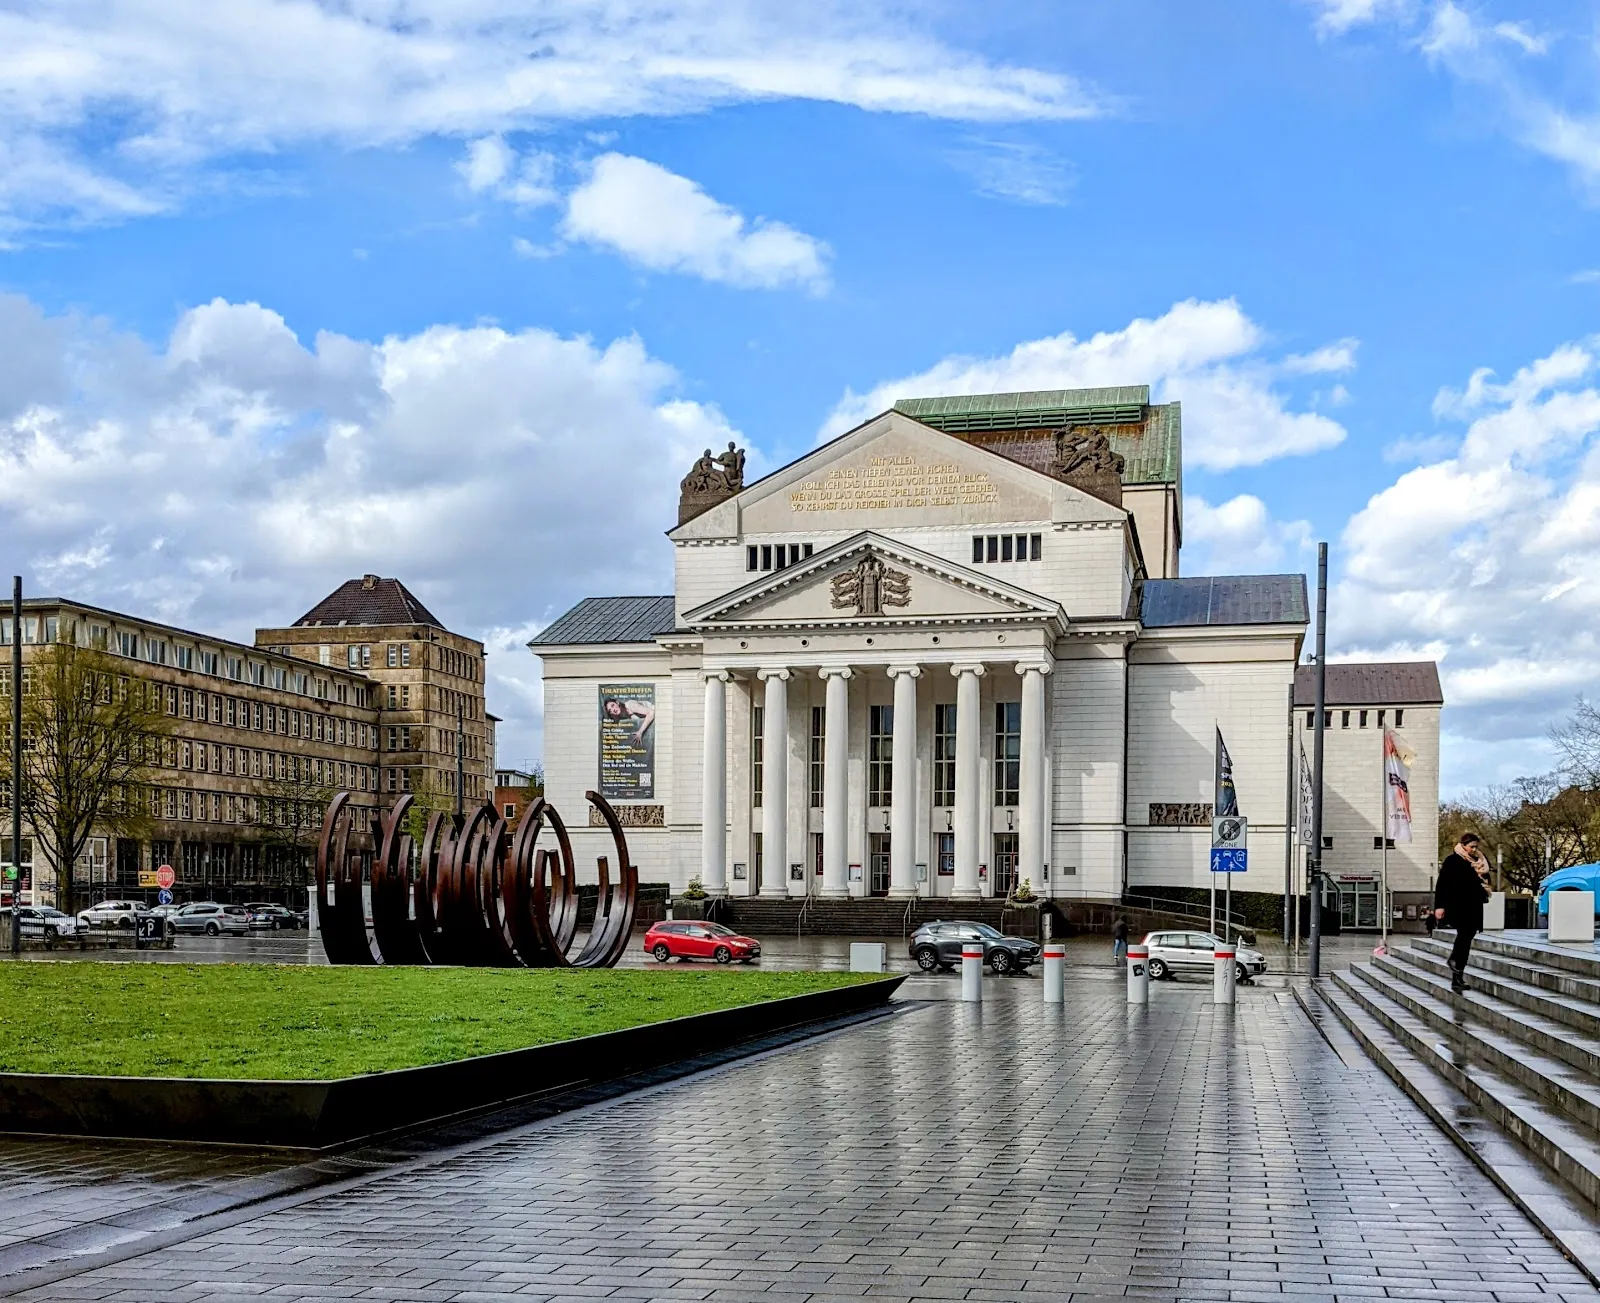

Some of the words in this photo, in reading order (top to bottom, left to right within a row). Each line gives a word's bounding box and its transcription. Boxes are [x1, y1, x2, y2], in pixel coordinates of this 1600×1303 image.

[871, 458, 886, 466] MIT
[889, 456, 916, 465] ALLEN
[829, 470, 858, 479] SEINEN
[861, 468, 890, 477] TIEFEN
[894, 466, 924, 476] SEINEN
[825, 481, 840, 489] ICH
[842, 480, 860, 488] DAS
[864, 479, 889, 488] LEBEN
[906, 477, 924, 486] VOR
[928, 476, 960, 484] DEINEM
[964, 473, 988, 482] BLICK
[791, 492, 816, 501] WENN
[820, 492, 832, 500] DU
[835, 491, 852, 499] DAS
[854, 490, 887, 498] GROSSE
[890, 488, 913, 497] SPIEL
[914, 487, 931, 496] DER
[934, 486, 957, 495] WELT
[960, 484, 998, 494] GESEHEN
[791, 503, 803, 512] SO
[806, 502, 837, 511] KEHRST
[840, 501, 853, 510] DU
[856, 500, 890, 509] REICHER
[894, 499, 902, 507] IN
[906, 498, 926, 507] DICH
[930, 496, 960, 506] SELBST
[962, 494, 997, 504] ZURÜCK
[159, 872, 173, 882] STOP
[148, 923, 154, 936] P
